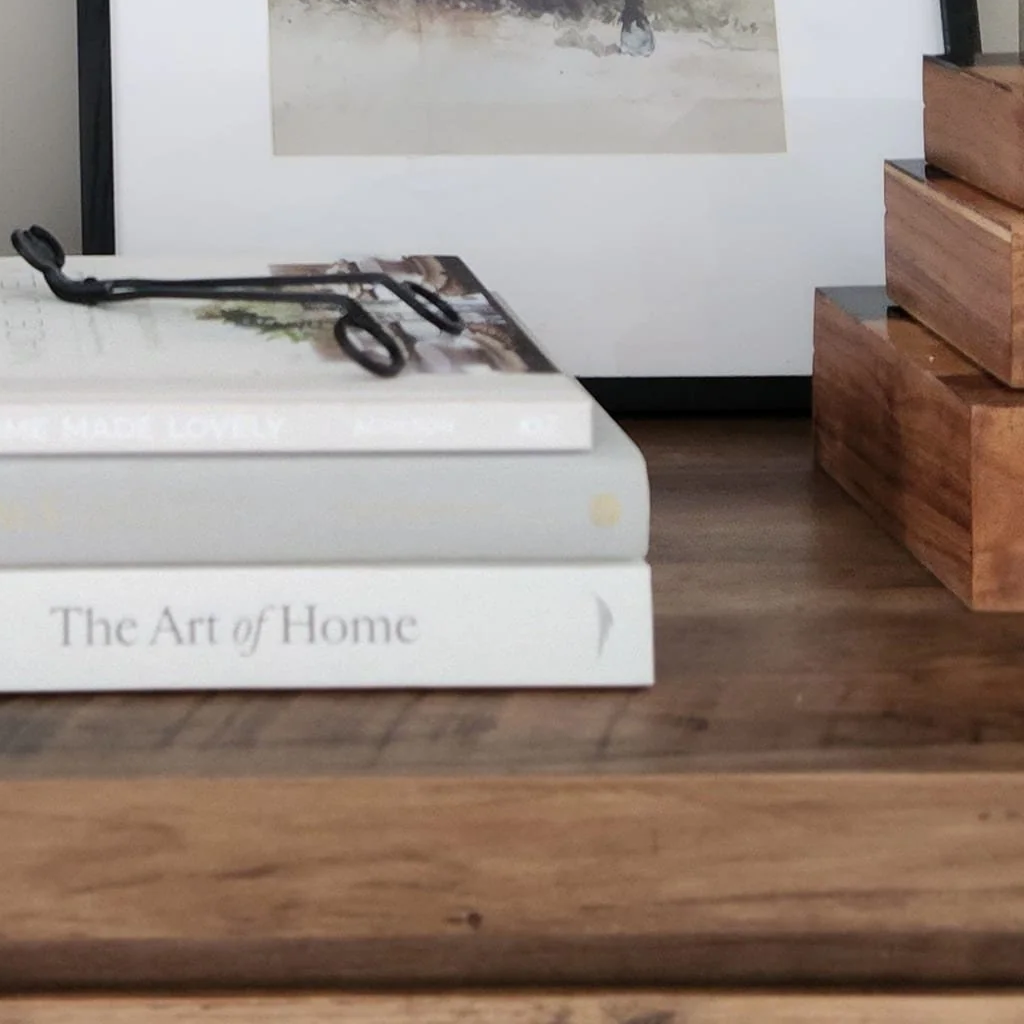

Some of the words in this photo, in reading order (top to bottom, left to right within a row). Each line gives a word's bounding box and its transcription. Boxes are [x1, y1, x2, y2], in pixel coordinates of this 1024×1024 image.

[61, 415, 153, 440] MADE
[168, 414, 287, 440] LOVELY
[49, 605, 138, 647] The
[149, 605, 220, 647] Art
[233, 604, 275, 657] of
[281, 603, 418, 646] Home
